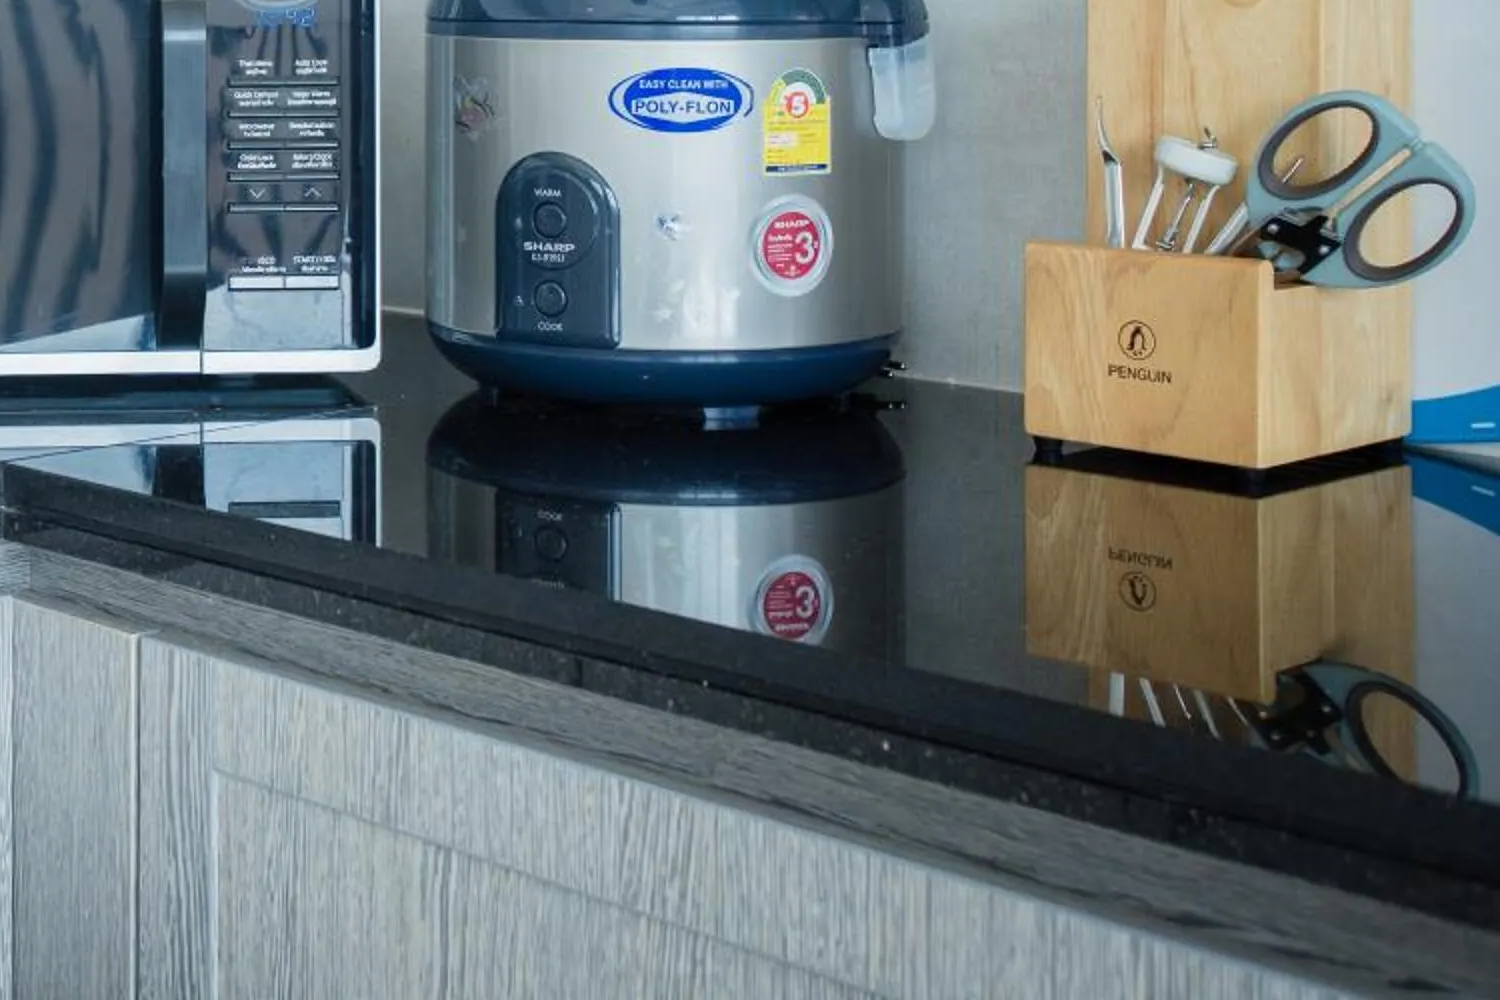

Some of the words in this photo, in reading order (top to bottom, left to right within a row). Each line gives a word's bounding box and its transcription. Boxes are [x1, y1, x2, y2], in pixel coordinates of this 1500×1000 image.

[639, 79, 666, 89] EASY
[667, 79, 701, 89] CLEAN
[634, 101, 732, 114] POLY-FLON
[533, 188, 563, 197] WARM
[523, 241, 576, 253] SHARP
[795, 231, 815, 264] 3
[537, 321, 564, 331] COOK
[1107, 364, 1173, 384] PENGUIN
